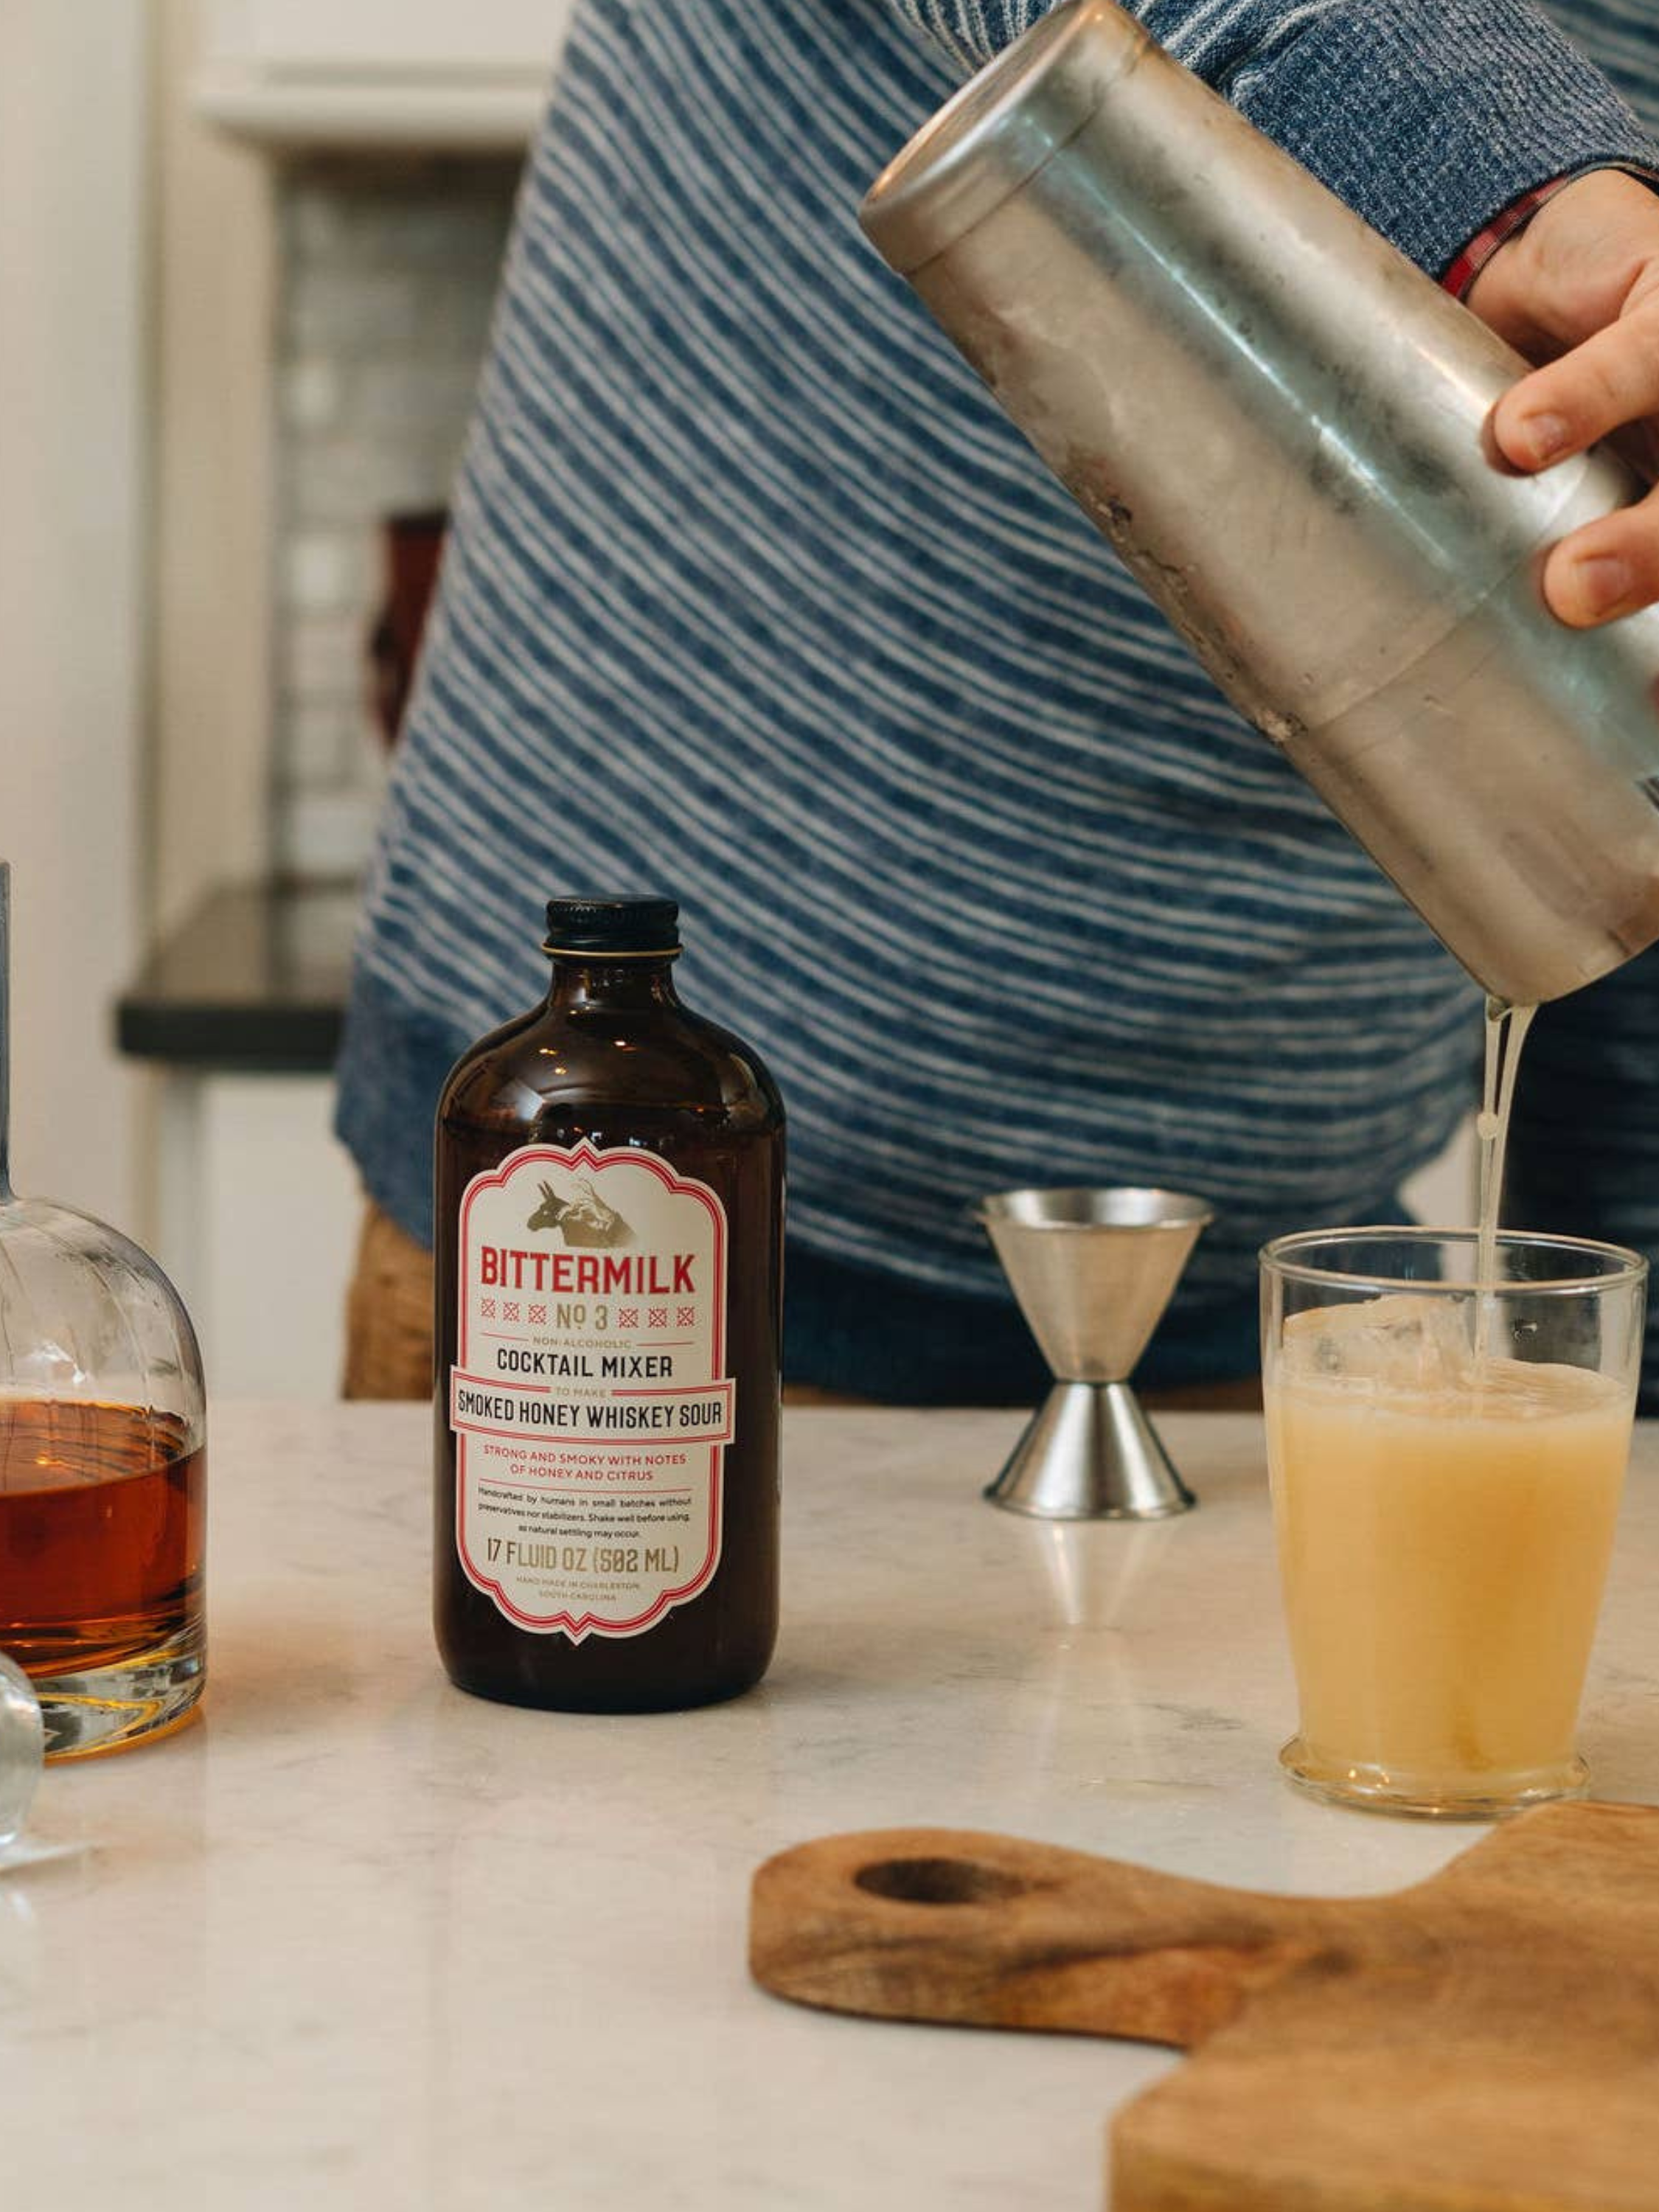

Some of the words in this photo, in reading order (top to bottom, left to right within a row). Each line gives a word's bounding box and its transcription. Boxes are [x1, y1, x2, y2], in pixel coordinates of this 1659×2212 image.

[481, 1246, 695, 1295] BITTERMILK
[595, 1304, 608, 1329] 3
[497, 1349, 593, 1377] COCKTAIL
[602, 1356, 672, 1377] MIXER
[556, 1386, 568, 1397] TO
[574, 1386, 606, 1398] MAKE
[457, 1389, 514, 1420] SMOKED
[520, 1402, 580, 1426] HONEY
[586, 1405, 675, 1428] WHISKEY
[680, 1402, 722, 1425] SOUR
[484, 1444, 526, 1459] STRONG
[530, 1452, 556, 1463] AND
[560, 1453, 604, 1465] SMOKY
[608, 1455, 641, 1465] WITH
[646, 1453, 686, 1465] NOTES
[510, 1464, 525, 1475] OF
[529, 1466, 572, 1478] HONEY
[576, 1470, 602, 1481] AND
[607, 1471, 653, 1481] CITRUS
[487, 1537, 501, 1562] 17
[507, 1541, 557, 1571] FLUID
[562, 1546, 588, 1573] OZ
[594, 1546, 639, 1573] (502
[644, 1545, 679, 1573] ML)
